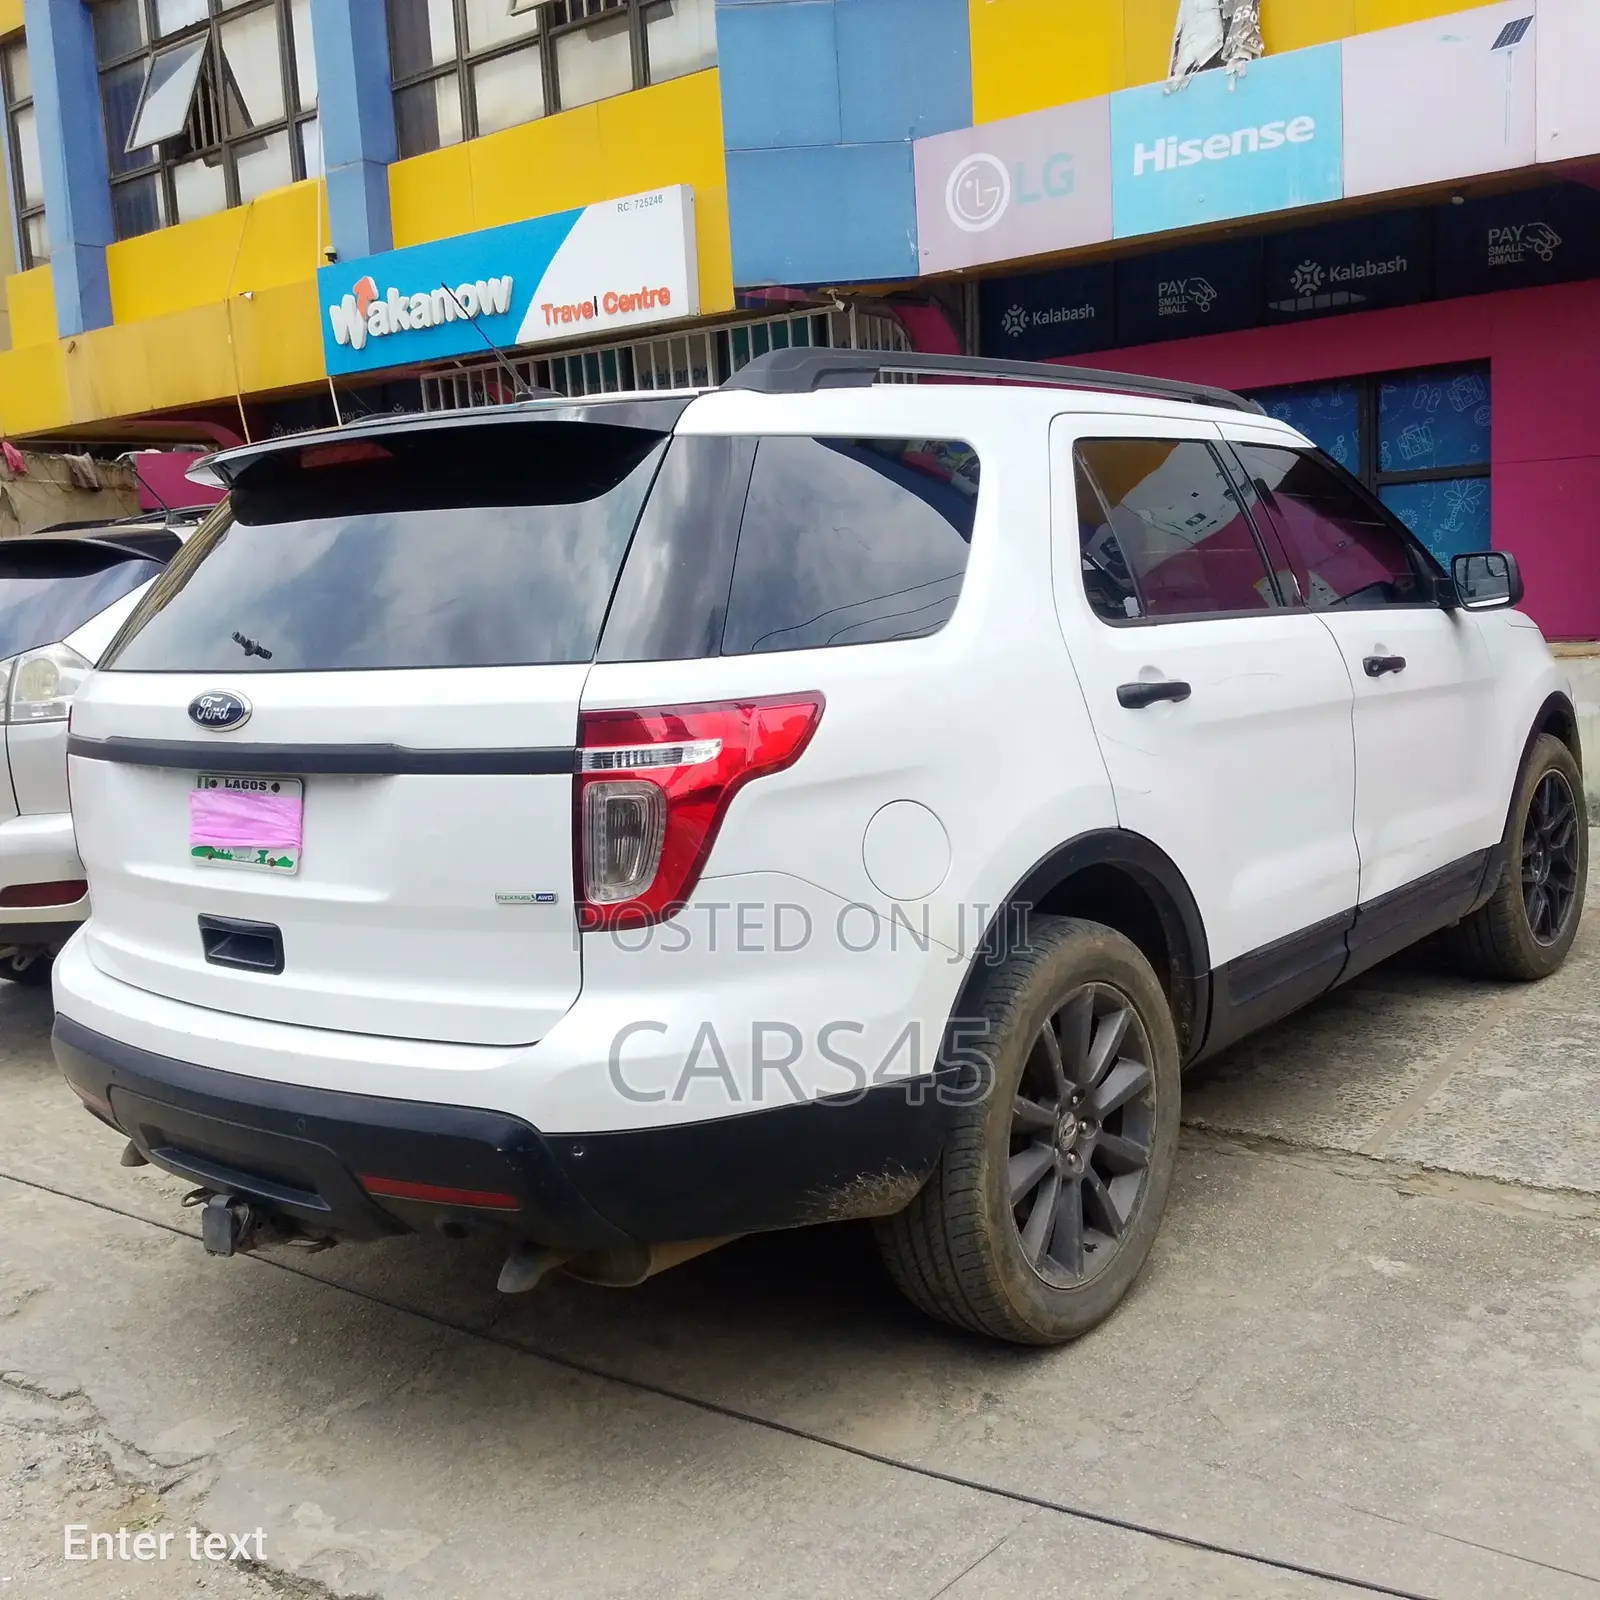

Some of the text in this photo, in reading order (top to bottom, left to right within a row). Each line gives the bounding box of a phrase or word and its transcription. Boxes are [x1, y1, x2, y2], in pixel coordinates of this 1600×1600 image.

[1132, 115, 1316, 176] Hisense
[1014, 151, 1075, 206] LG
[634, 194, 663, 209] 725248
[1488, 225, 1525, 246] PAY
[1488, 243, 1525, 256] SMALL
[1488, 253, 1525, 266] SMALL
[1328, 256, 1408, 283] Kalabash
[1158, 279, 1187, 297] PAY
[541, 285, 671, 326] Travel Centre
[1158, 296, 1188, 307] SMALL
[1158, 305, 1188, 316] SMALL
[329, 275, 513, 350] Wakanow
[1032, 303, 1095, 326] Kalabash
[196, 695, 232, 720] Ford
[224, 779, 267, 791] LAGOS
